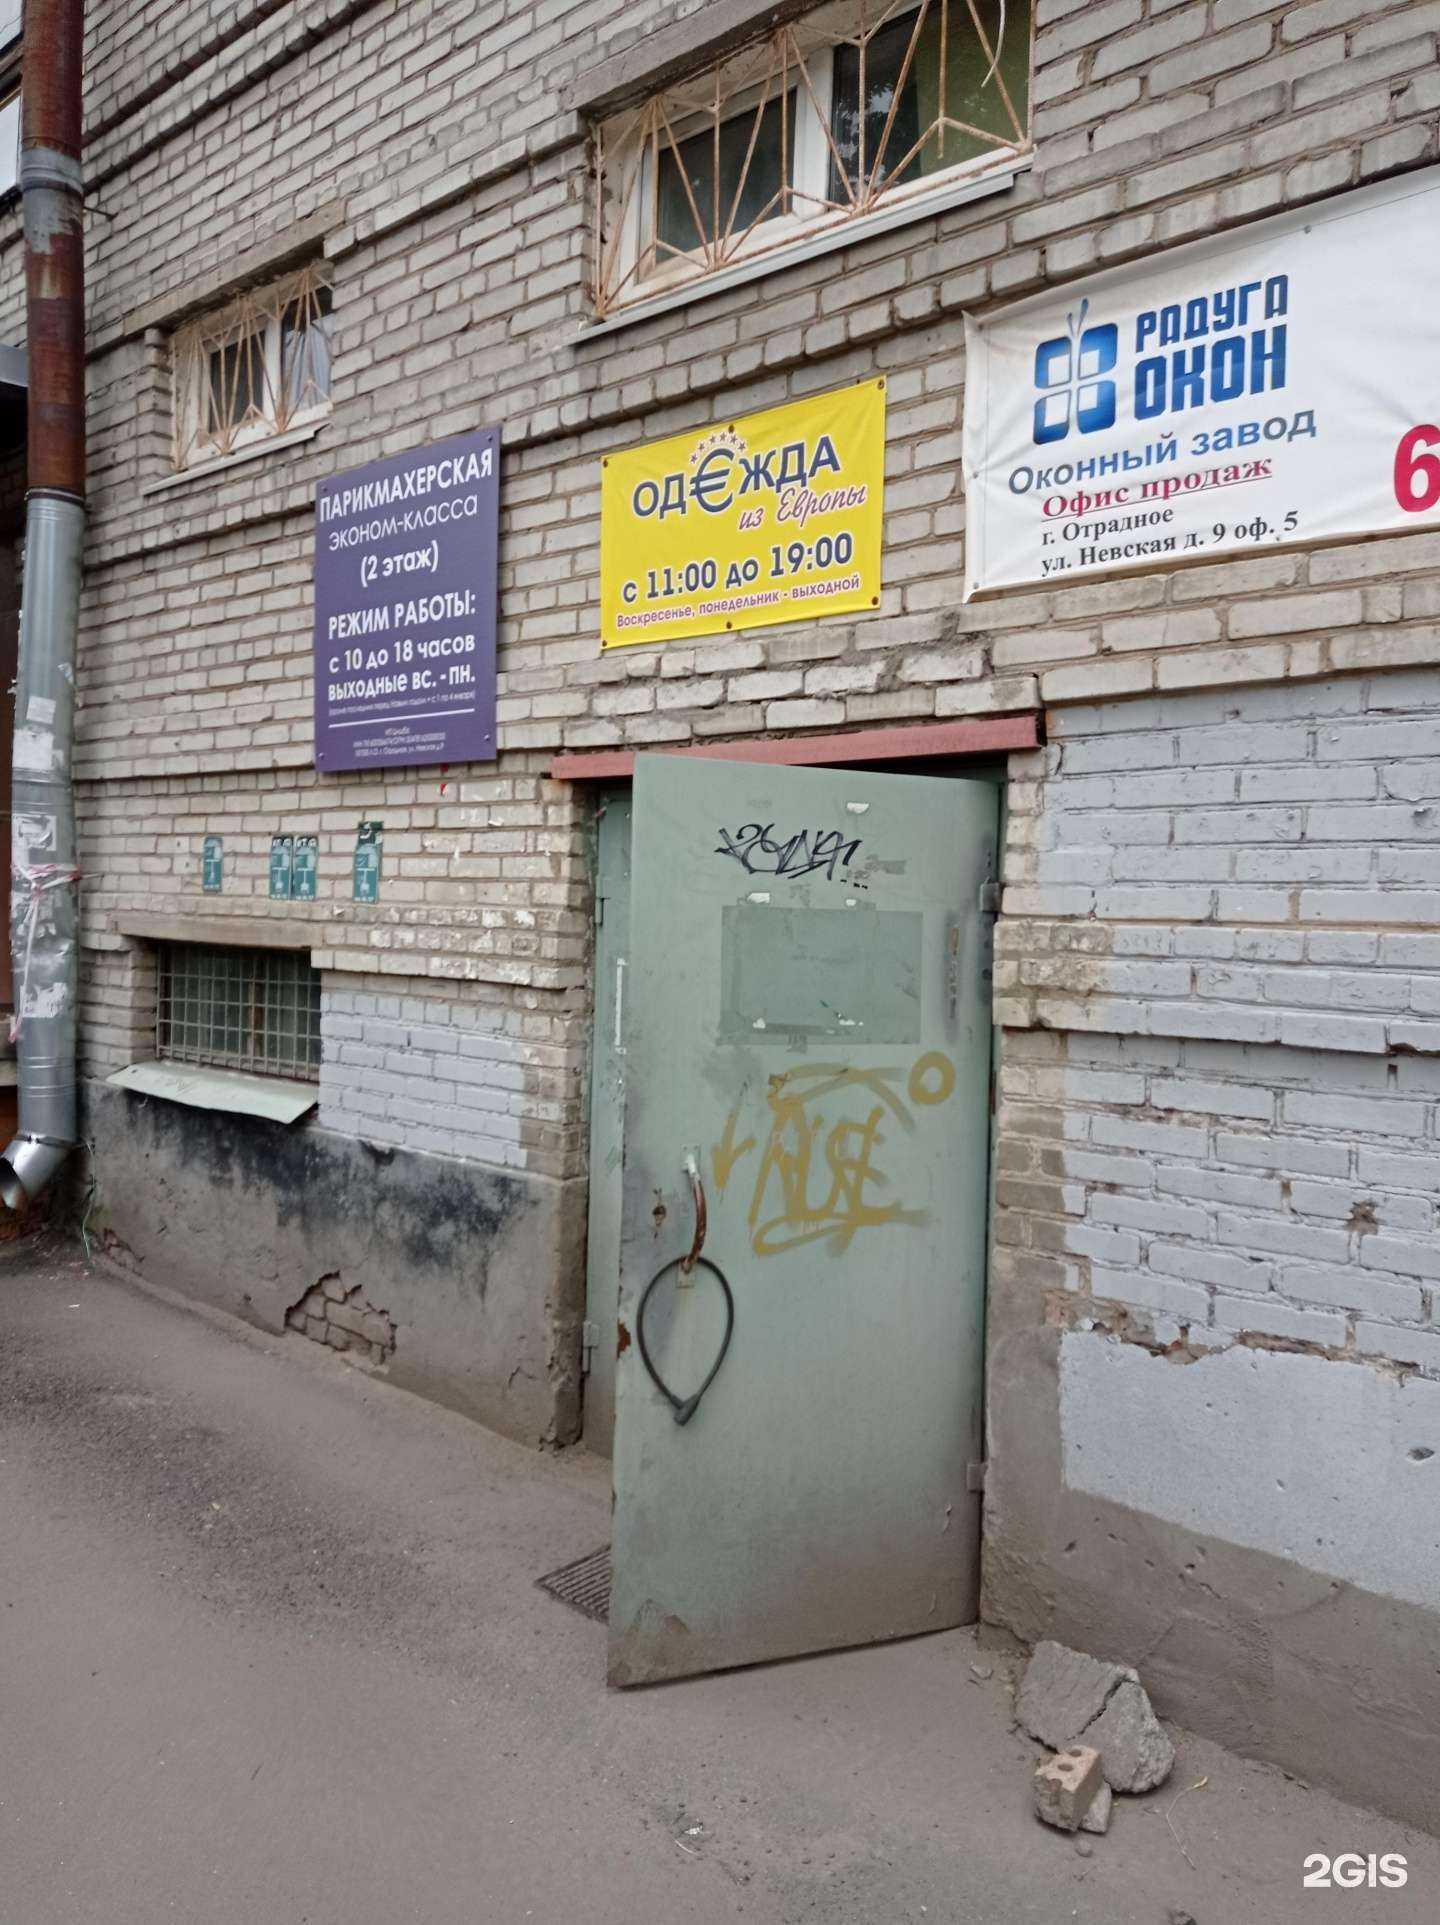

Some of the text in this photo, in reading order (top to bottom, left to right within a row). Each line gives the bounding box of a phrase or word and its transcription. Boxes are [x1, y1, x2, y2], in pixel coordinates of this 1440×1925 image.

[1135, 273, 1289, 353] РАДУГА
[1133, 324, 1288, 421] ОКОН
[1008, 409, 1317, 495] Оконный завод
[319, 448, 493, 523] ПАРИКМАХЕРСКАЯ
[738, 485, 867, 531] из Европы
[1043, 458, 1273, 518] Офис продаж
[1041, 510, 1298, 577] ул. Невская д. 9 оф. 5
[1042, 508, 1174, 546] г. Отрадное
[360, 540, 439, 588] (2 этаж)
[647, 560, 717, 599] 11:00
[726, 558, 759, 588] до
[771, 533, 853, 577] 19:00
[328, 590, 476, 640] РЕЖИМ РАБОТЫ:
[617, 604, 696, 627] Воскресенье,
[699, 591, 779, 615] понедельник
[791, 574, 860, 599] выходной
[344, 648, 363, 671] 10
[365, 651, 388, 671] до
[393, 639, 413, 663] 18
[417, 634, 475, 659] часов
